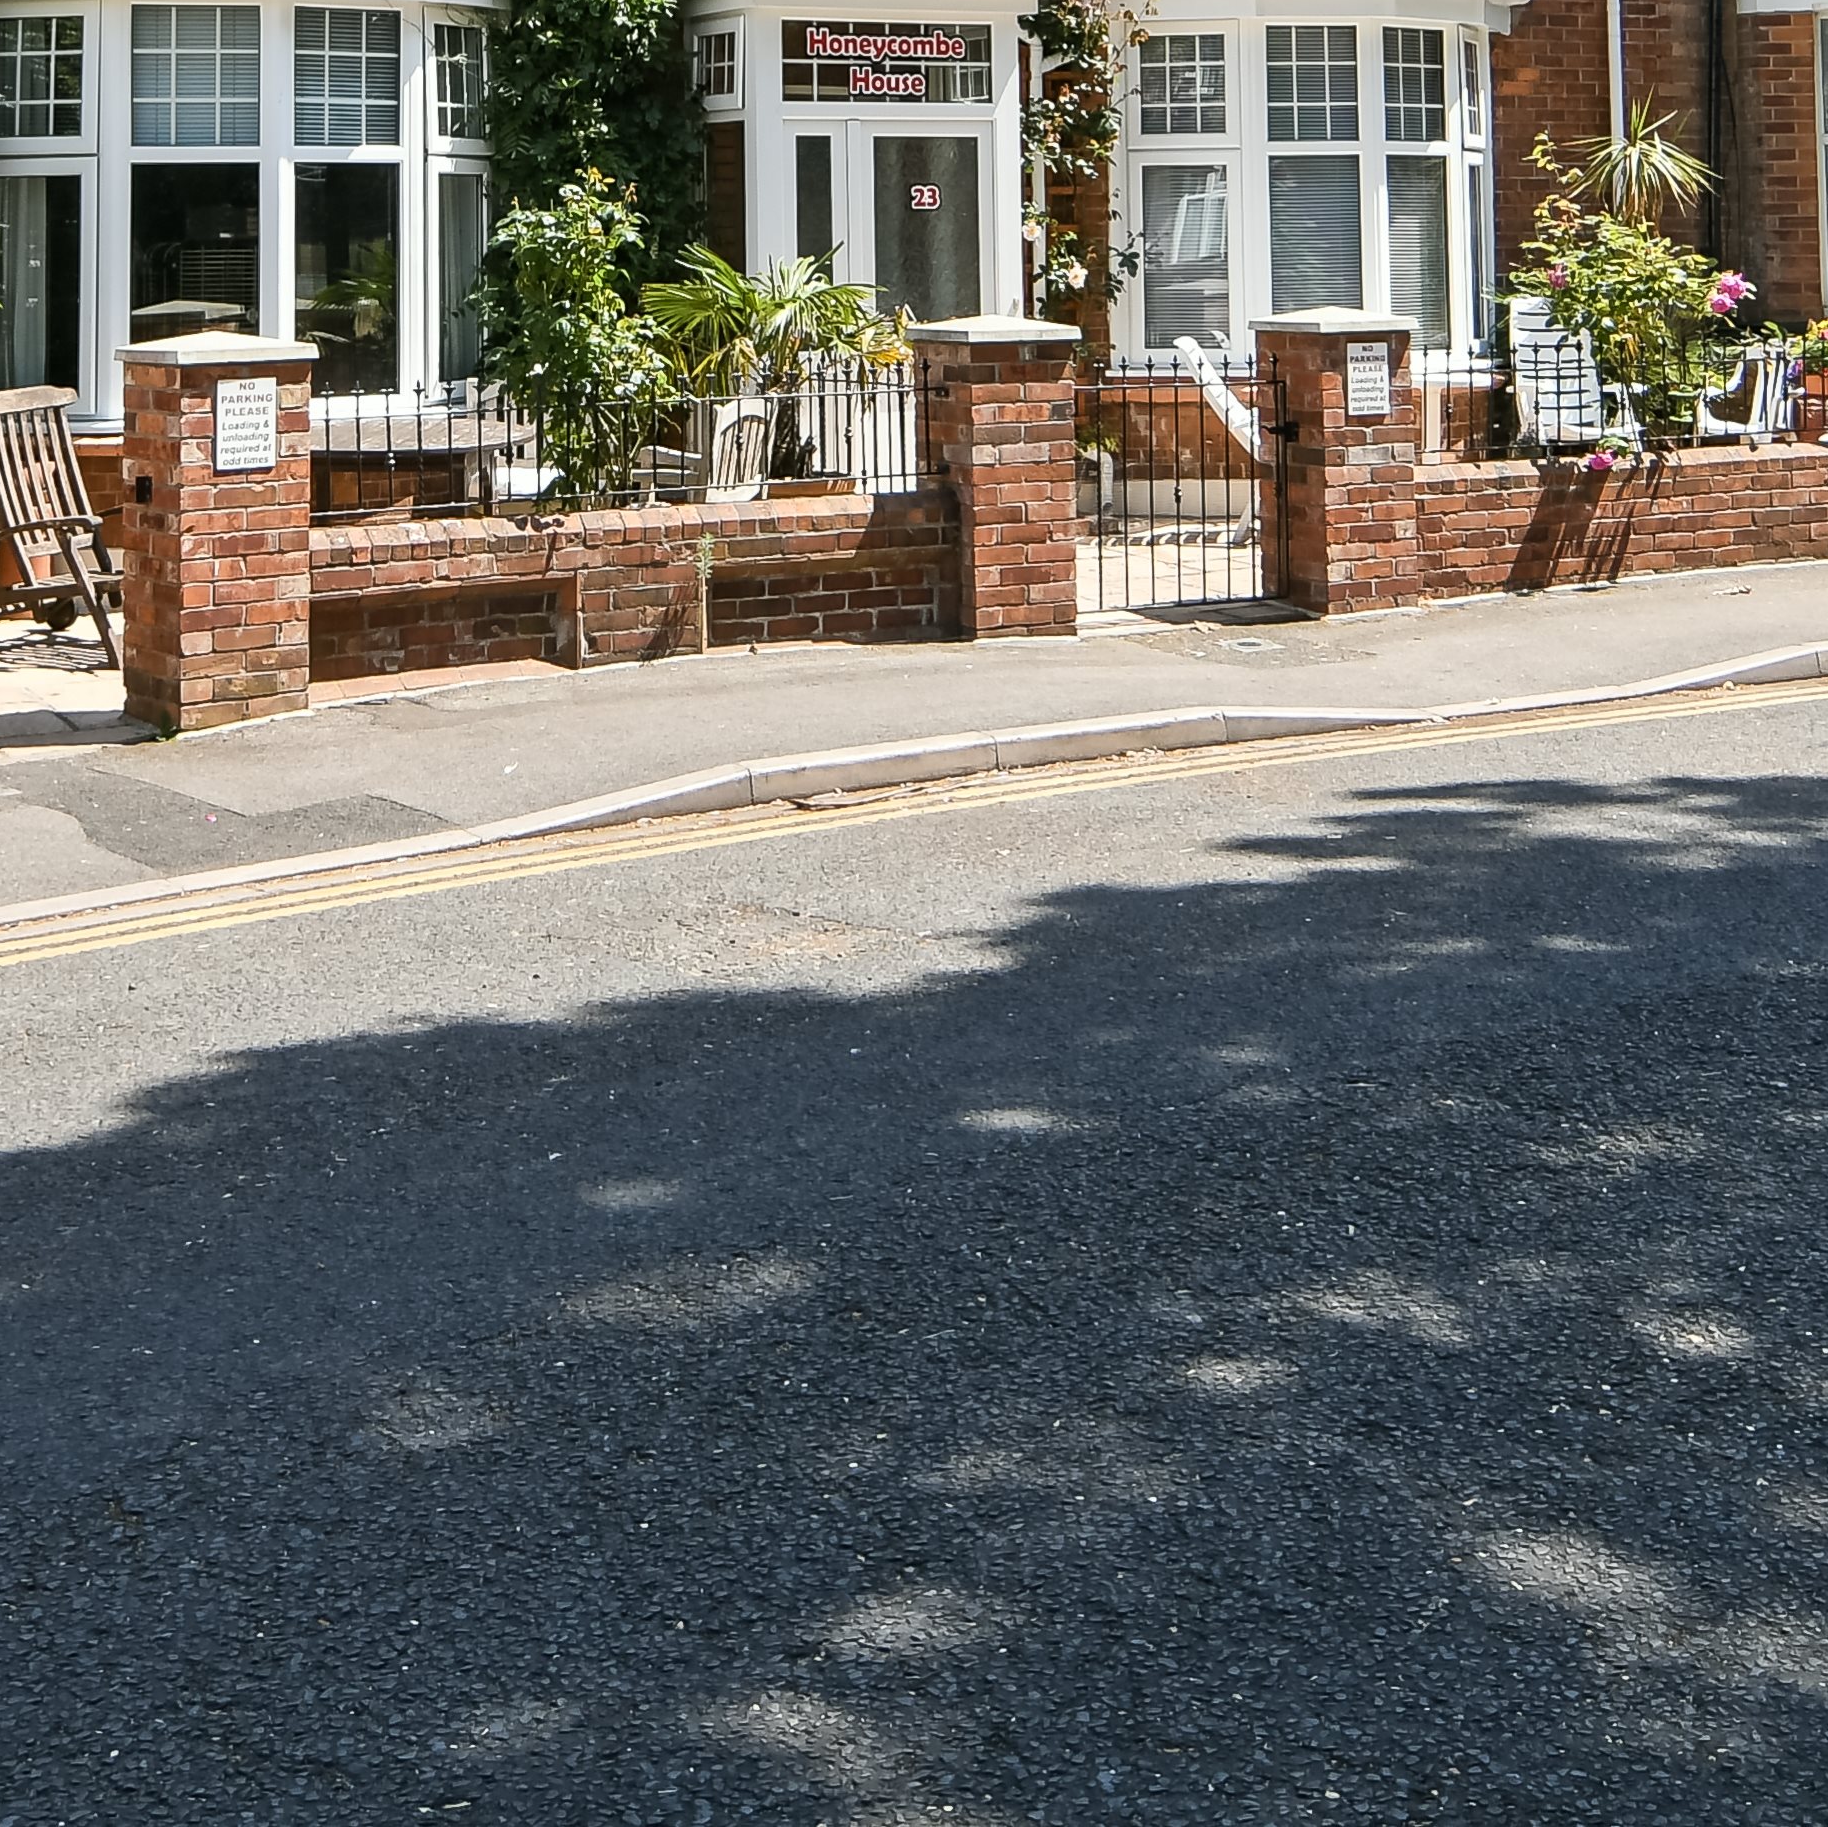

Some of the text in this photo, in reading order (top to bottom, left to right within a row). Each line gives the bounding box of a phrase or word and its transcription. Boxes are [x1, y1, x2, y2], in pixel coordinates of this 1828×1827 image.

[807, 27, 965, 60] Honeycombe
[850, 66, 925, 95] House
[911, 185, 940, 210] 23
[1349, 355, 1386, 363] PARKING
[1352, 365, 1383, 373] PLEASE
[239, 382, 256, 391] NO
[221, 393, 273, 404] PARKING
[225, 406, 270, 417] PLEASE
[222, 419, 270, 431] Loading &
[222, 432, 270, 442] unloading
[220, 444, 272, 455] required at
[222, 456, 270, 466] odd times
